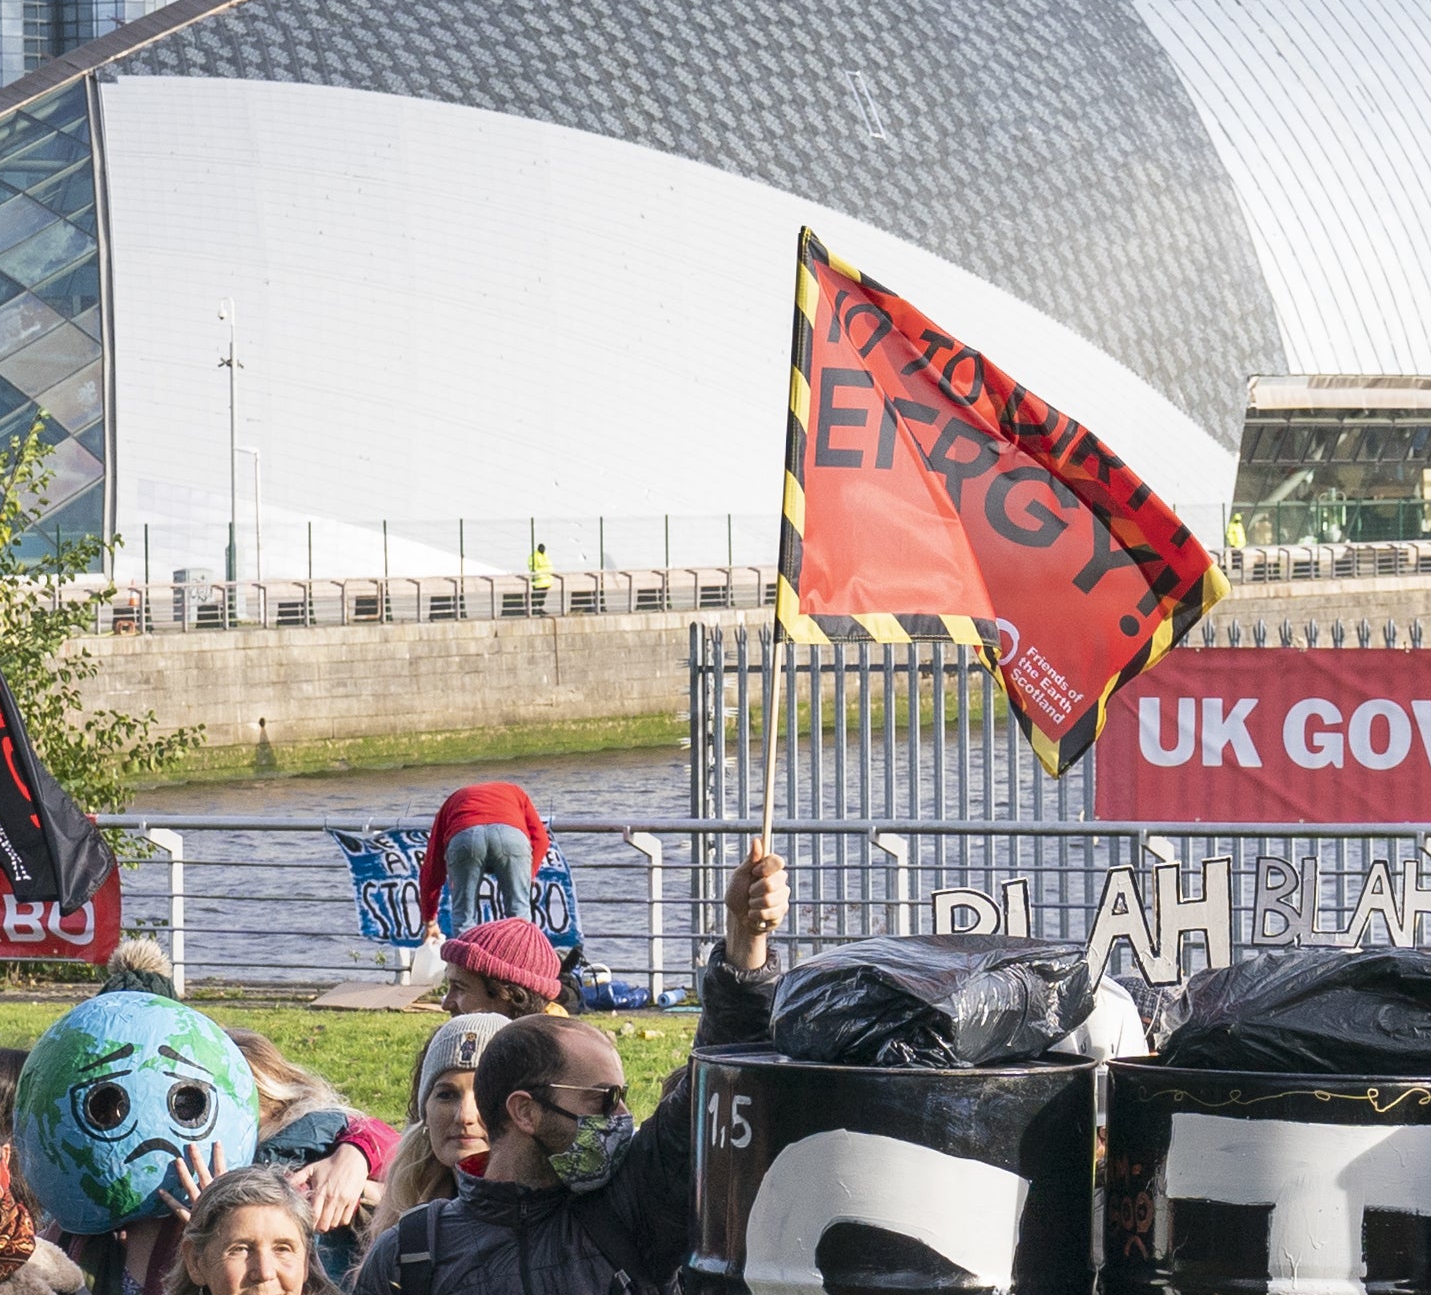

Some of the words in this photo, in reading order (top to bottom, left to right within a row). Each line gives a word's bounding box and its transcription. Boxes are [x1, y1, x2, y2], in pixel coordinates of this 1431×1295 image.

[1011, 668, 1065, 724] Scotland
[1018, 657, 1039, 679] the
[1040, 677, 1072, 713] Earth
[1027, 646, 1069, 691] Friends
[1068, 689, 1084, 703] of
[1138, 696, 1263, 770] UK
[363, 880, 423, 940] STO
[706, 1094, 753, 1149] 1,5
